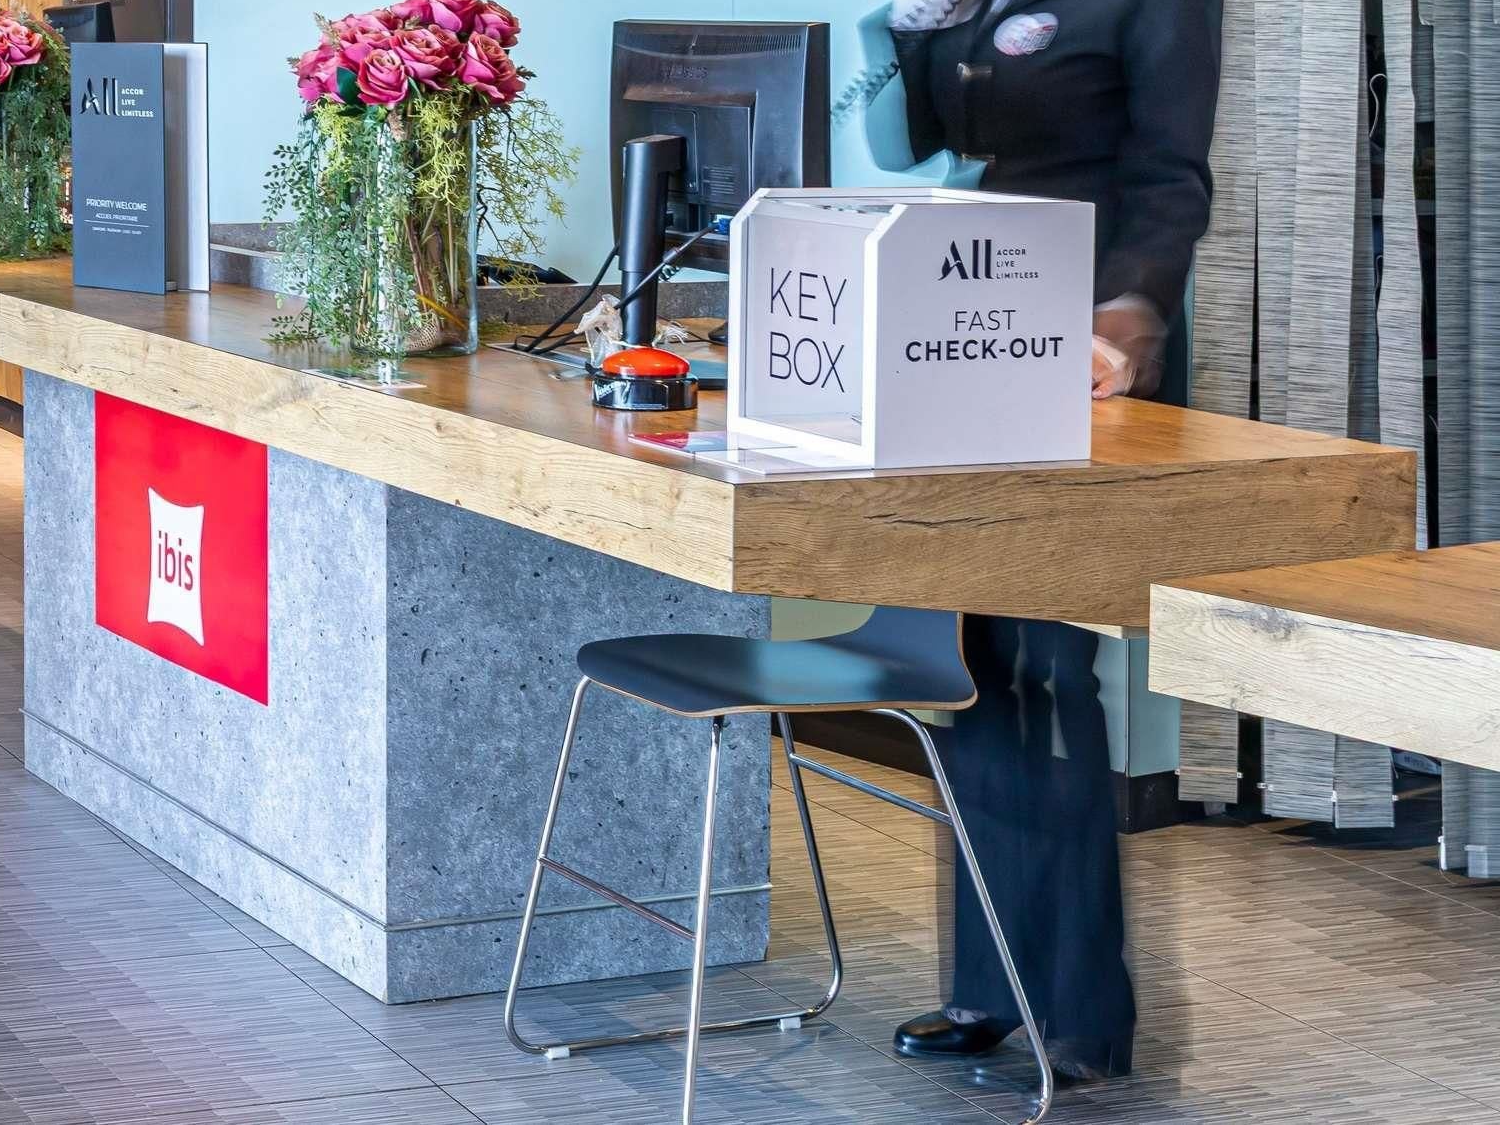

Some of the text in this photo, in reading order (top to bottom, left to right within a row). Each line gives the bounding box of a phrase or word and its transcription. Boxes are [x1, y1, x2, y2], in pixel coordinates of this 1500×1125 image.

[121, 109, 154, 118] LIMITLESS
[86, 198, 148, 212] PRIORITY WELCOME
[938, 238, 996, 281] All
[996, 247, 1027, 256] ACCOR
[996, 260, 1016, 268] LIVE
[996, 271, 1039, 279] LIMITLESS
[770, 267, 847, 325] KEY
[954, 309, 1017, 332] FAST
[905, 336, 1064, 363] CHECK-OUT
[769, 331, 846, 393] BOX
[158, 529, 194, 591] ibis
